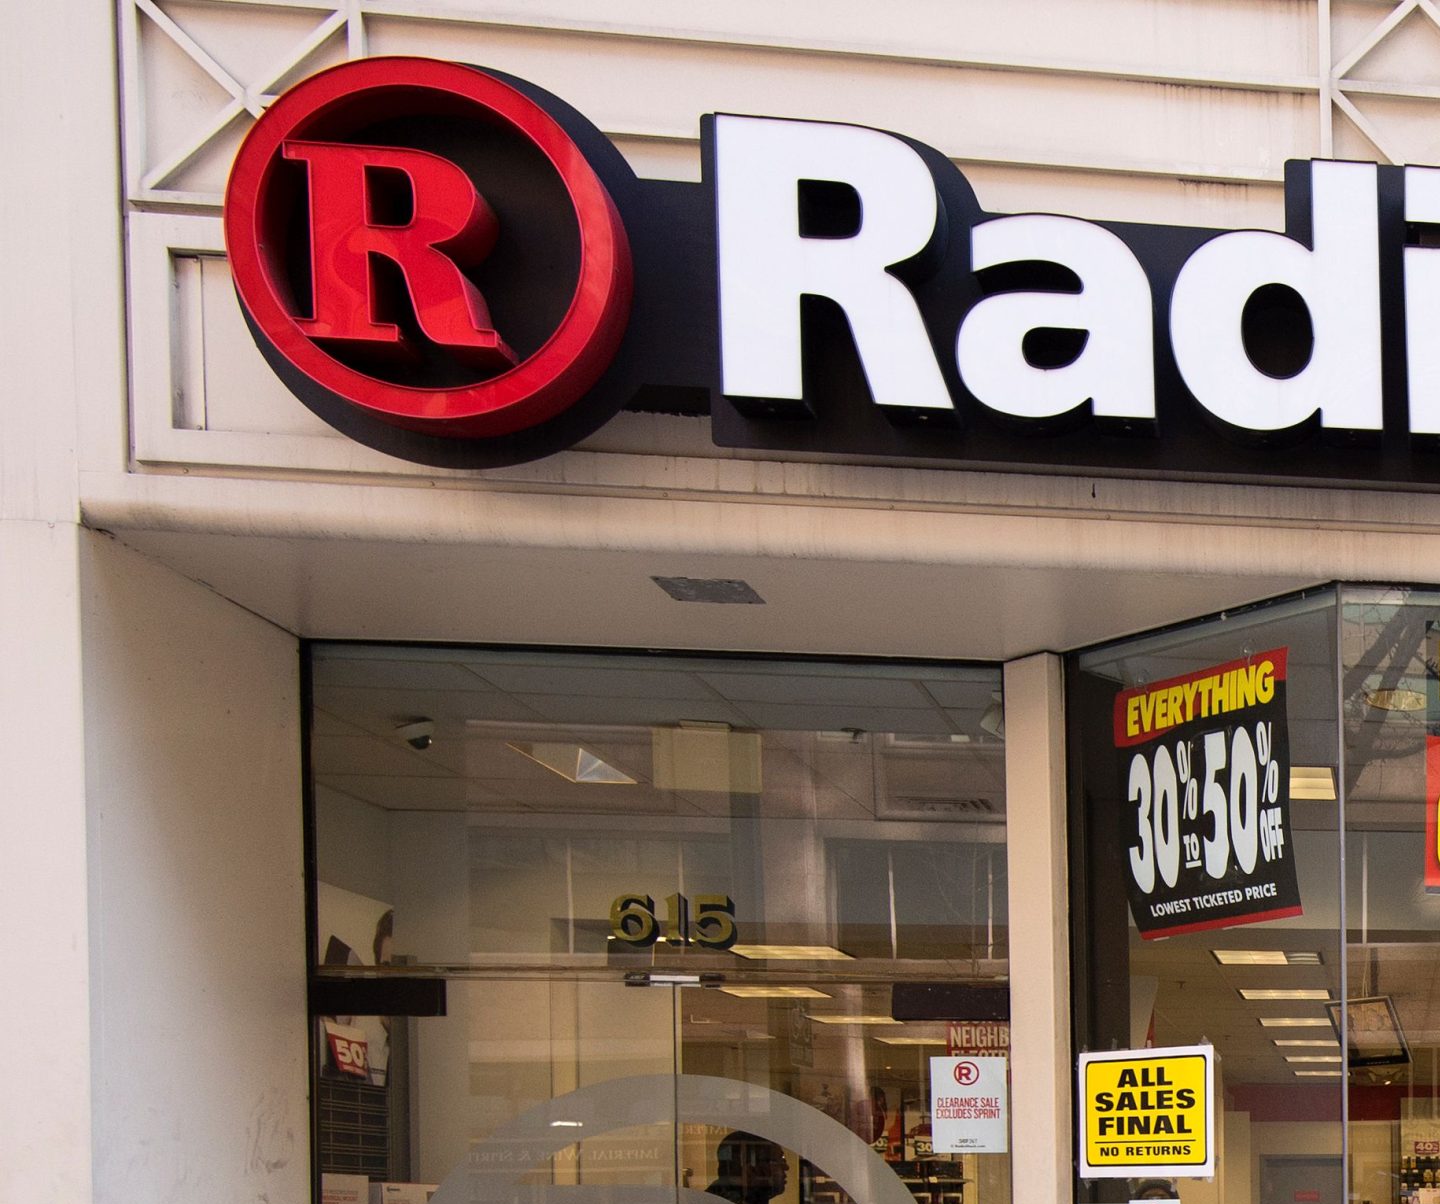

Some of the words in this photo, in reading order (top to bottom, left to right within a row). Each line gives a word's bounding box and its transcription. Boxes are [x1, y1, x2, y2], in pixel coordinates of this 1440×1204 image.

[1126, 661, 1275, 738] EVERYTHING
[1260, 806, 1285, 863] OFF
[1150, 897, 1190, 918] LOWEST
[1192, 889, 1243, 912] TICKETED
[1245, 882, 1278, 903] PRICE
[609, 892, 738, 951] 615
[1117, 1065, 1174, 1089] ALL
[937, 1097, 979, 1108] CLEARANCE
[980, 1097, 999, 1108] SALE
[1095, 1088, 1196, 1112] SALES
[936, 1109, 972, 1119] EXCLUDES
[974, 1108, 1000, 1119] SPRINT
[1099, 1115, 1193, 1138] FINAL
[1100, 1145, 1121, 1157] NO
[1126, 1144, 1191, 1156] RETURNS
